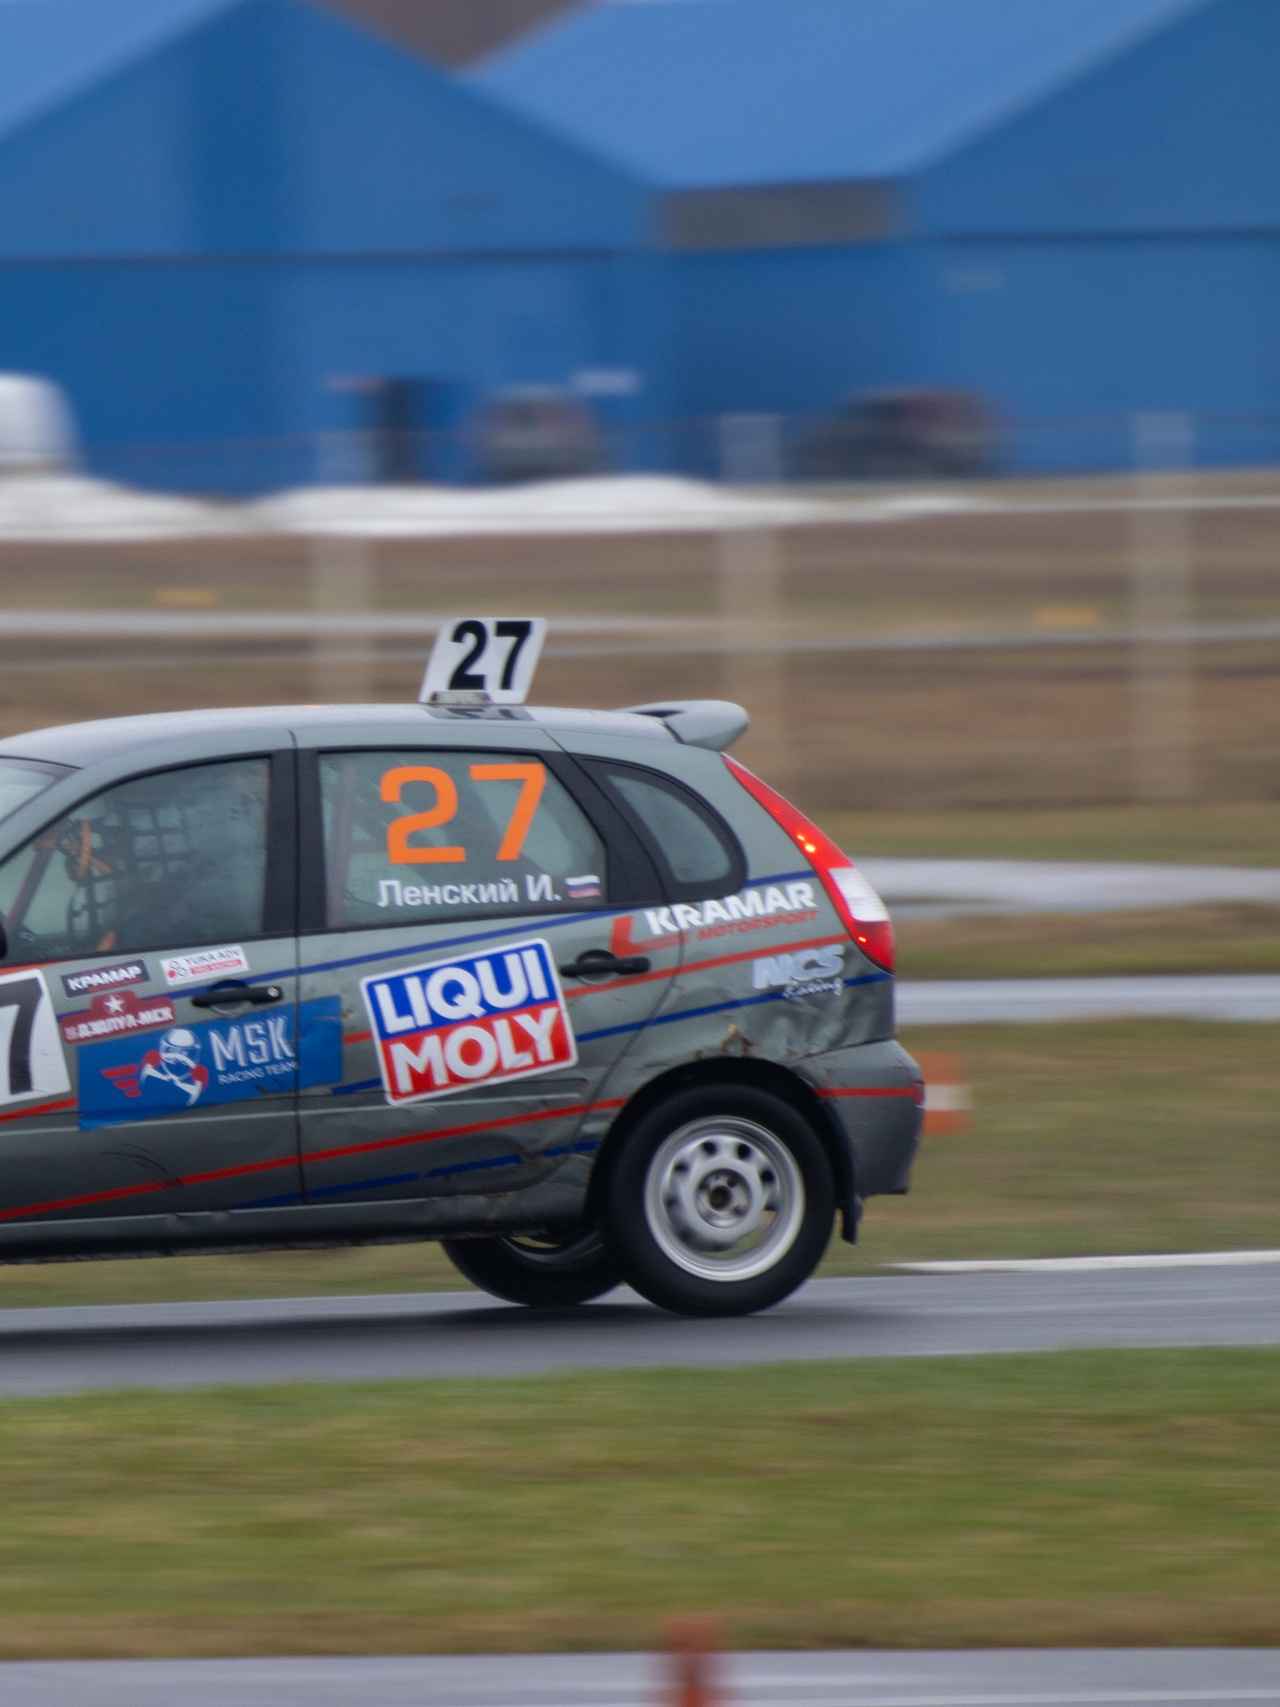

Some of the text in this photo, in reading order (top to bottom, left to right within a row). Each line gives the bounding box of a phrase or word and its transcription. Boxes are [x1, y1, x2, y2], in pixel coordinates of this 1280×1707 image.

[448, 619, 533, 691] 27
[379, 762, 547, 865] 27
[376, 873, 562, 908] Ленский И.
[643, 881, 819, 936] KRAMAR
[696, 909, 820, 941] MOTORSPORT
[373, 949, 550, 1035] LIQUI
[208, 1015, 297, 1071] MSK
[389, 1006, 560, 1094] MOLY
[217, 1060, 300, 1085] RACING TEAM
